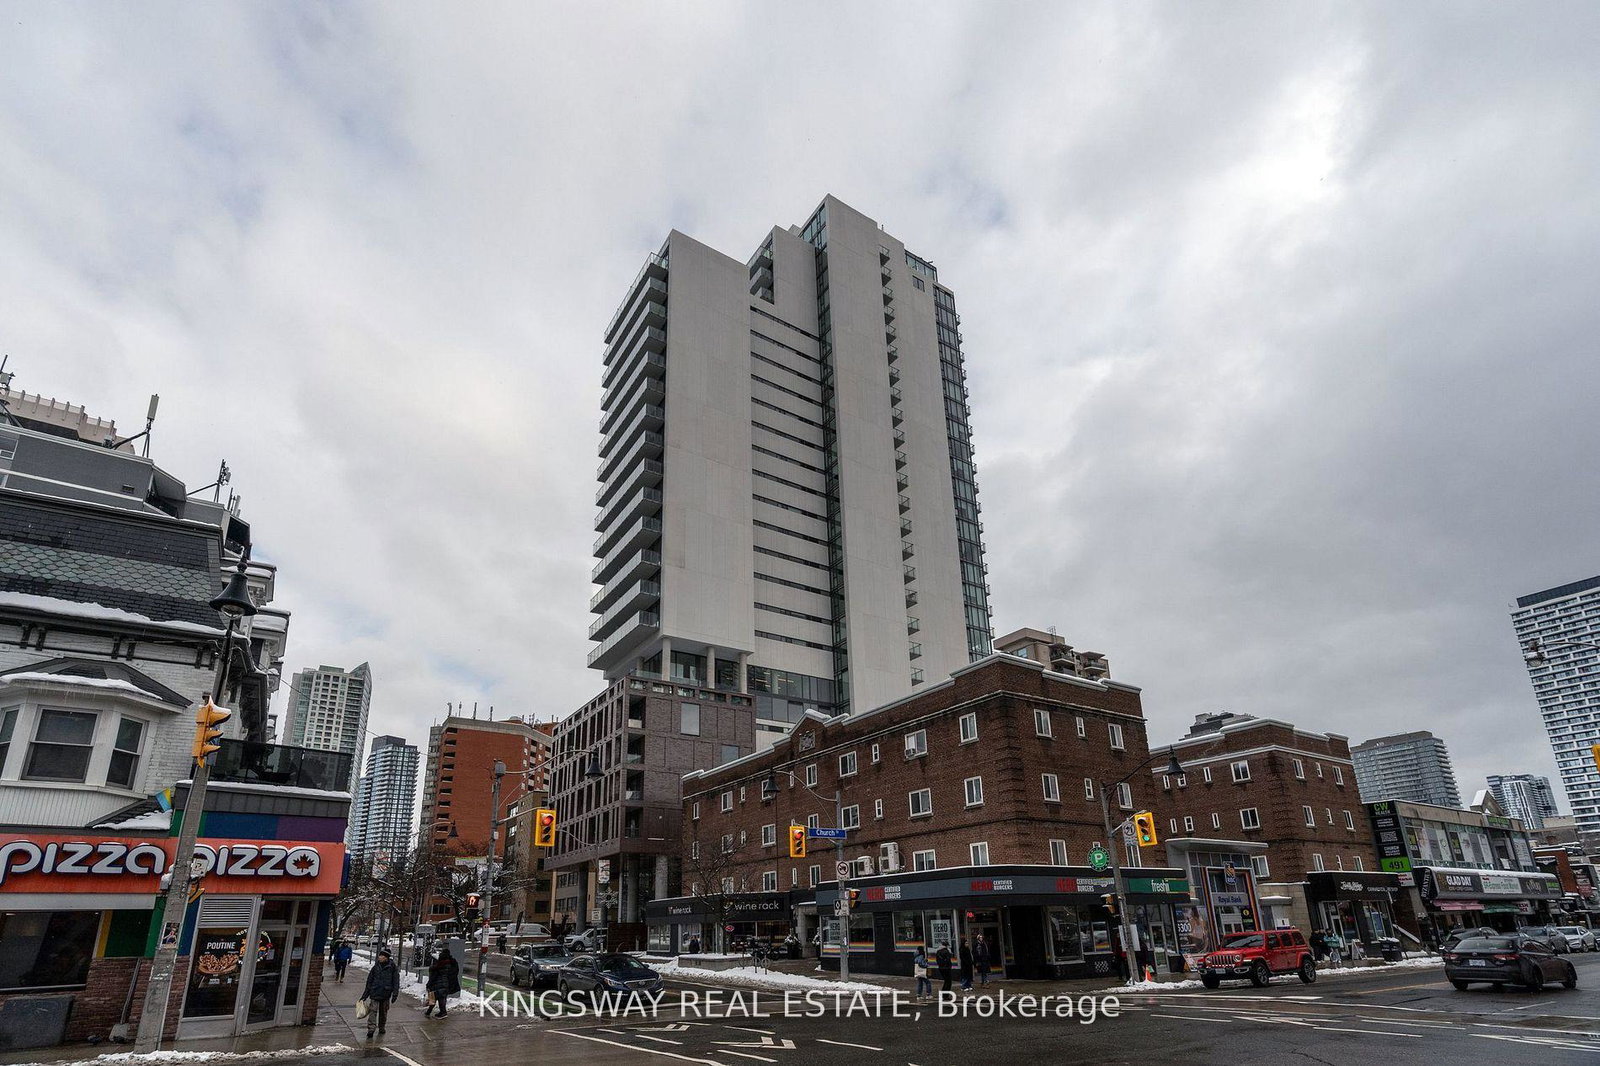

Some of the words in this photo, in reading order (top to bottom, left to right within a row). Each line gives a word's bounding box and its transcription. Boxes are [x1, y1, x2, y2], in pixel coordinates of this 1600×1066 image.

[0, 841, 165, 885] pizza
[1389, 861, 1404, 870] 491
[1151, 880, 1170, 892] freshii
[734, 902, 757, 911] wine
[758, 900, 779, 910] rack
[933, 923, 947, 933] HERO
[207, 941, 236, 950] POUTINE
